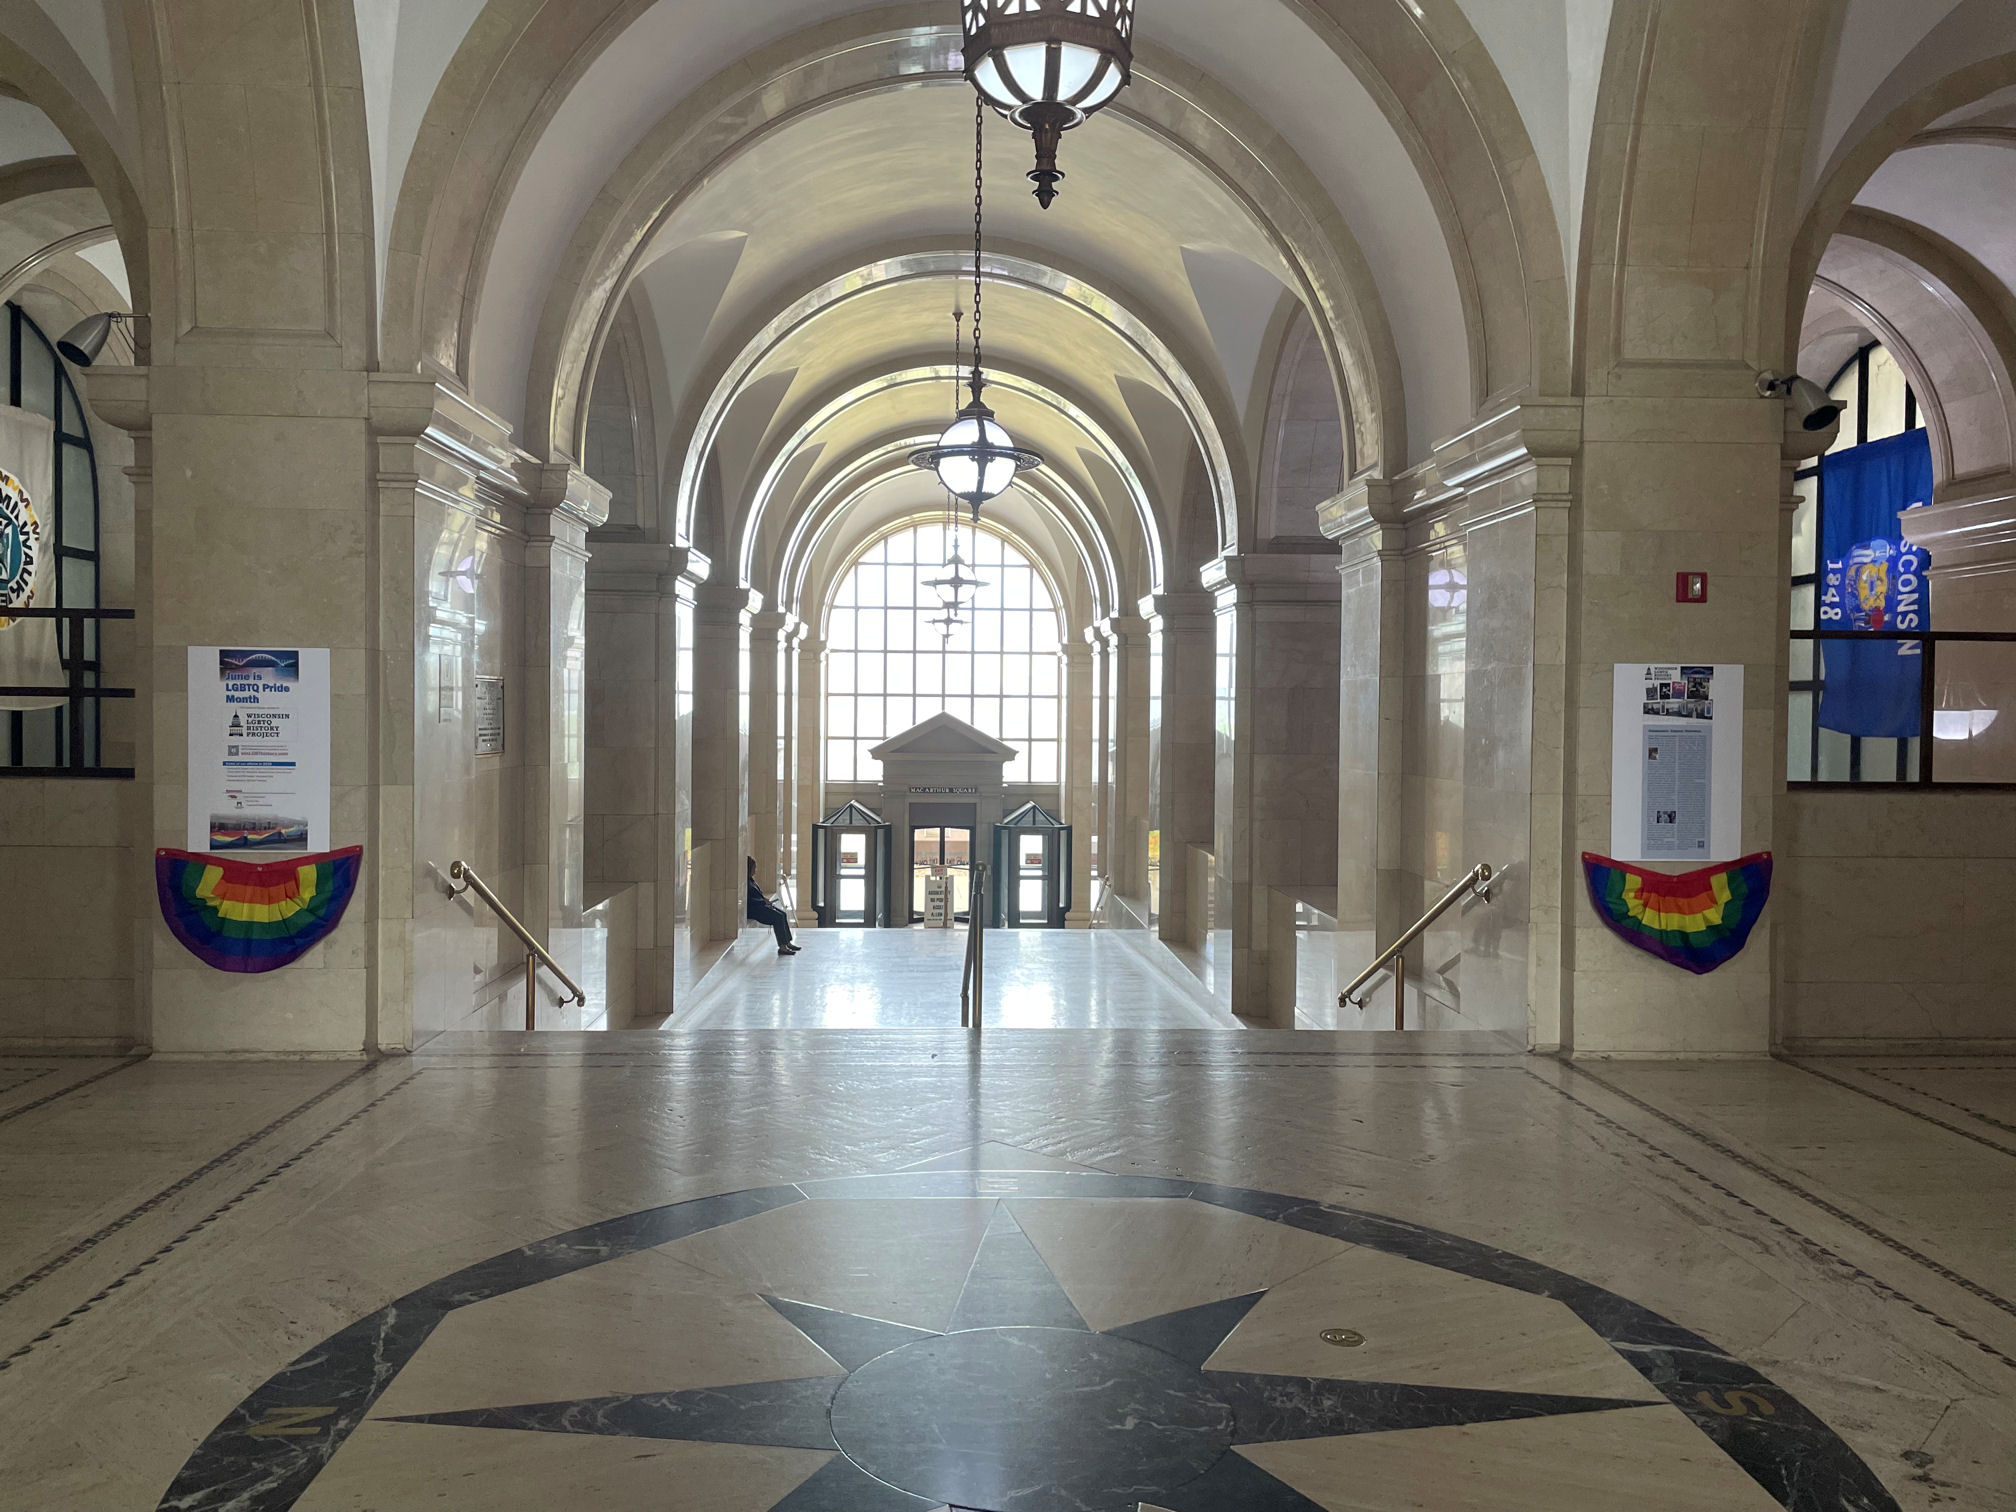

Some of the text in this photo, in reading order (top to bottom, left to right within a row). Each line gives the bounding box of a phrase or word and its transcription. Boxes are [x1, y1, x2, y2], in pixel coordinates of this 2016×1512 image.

[1820, 559, 1843, 620] 1848
[225, 672, 262, 681] June is
[225, 683, 290, 693] LGBTQ Pride
[225, 695, 260, 703] Month
[1696, 1390, 1775, 1416] S
[247, 1406, 338, 1436] N
